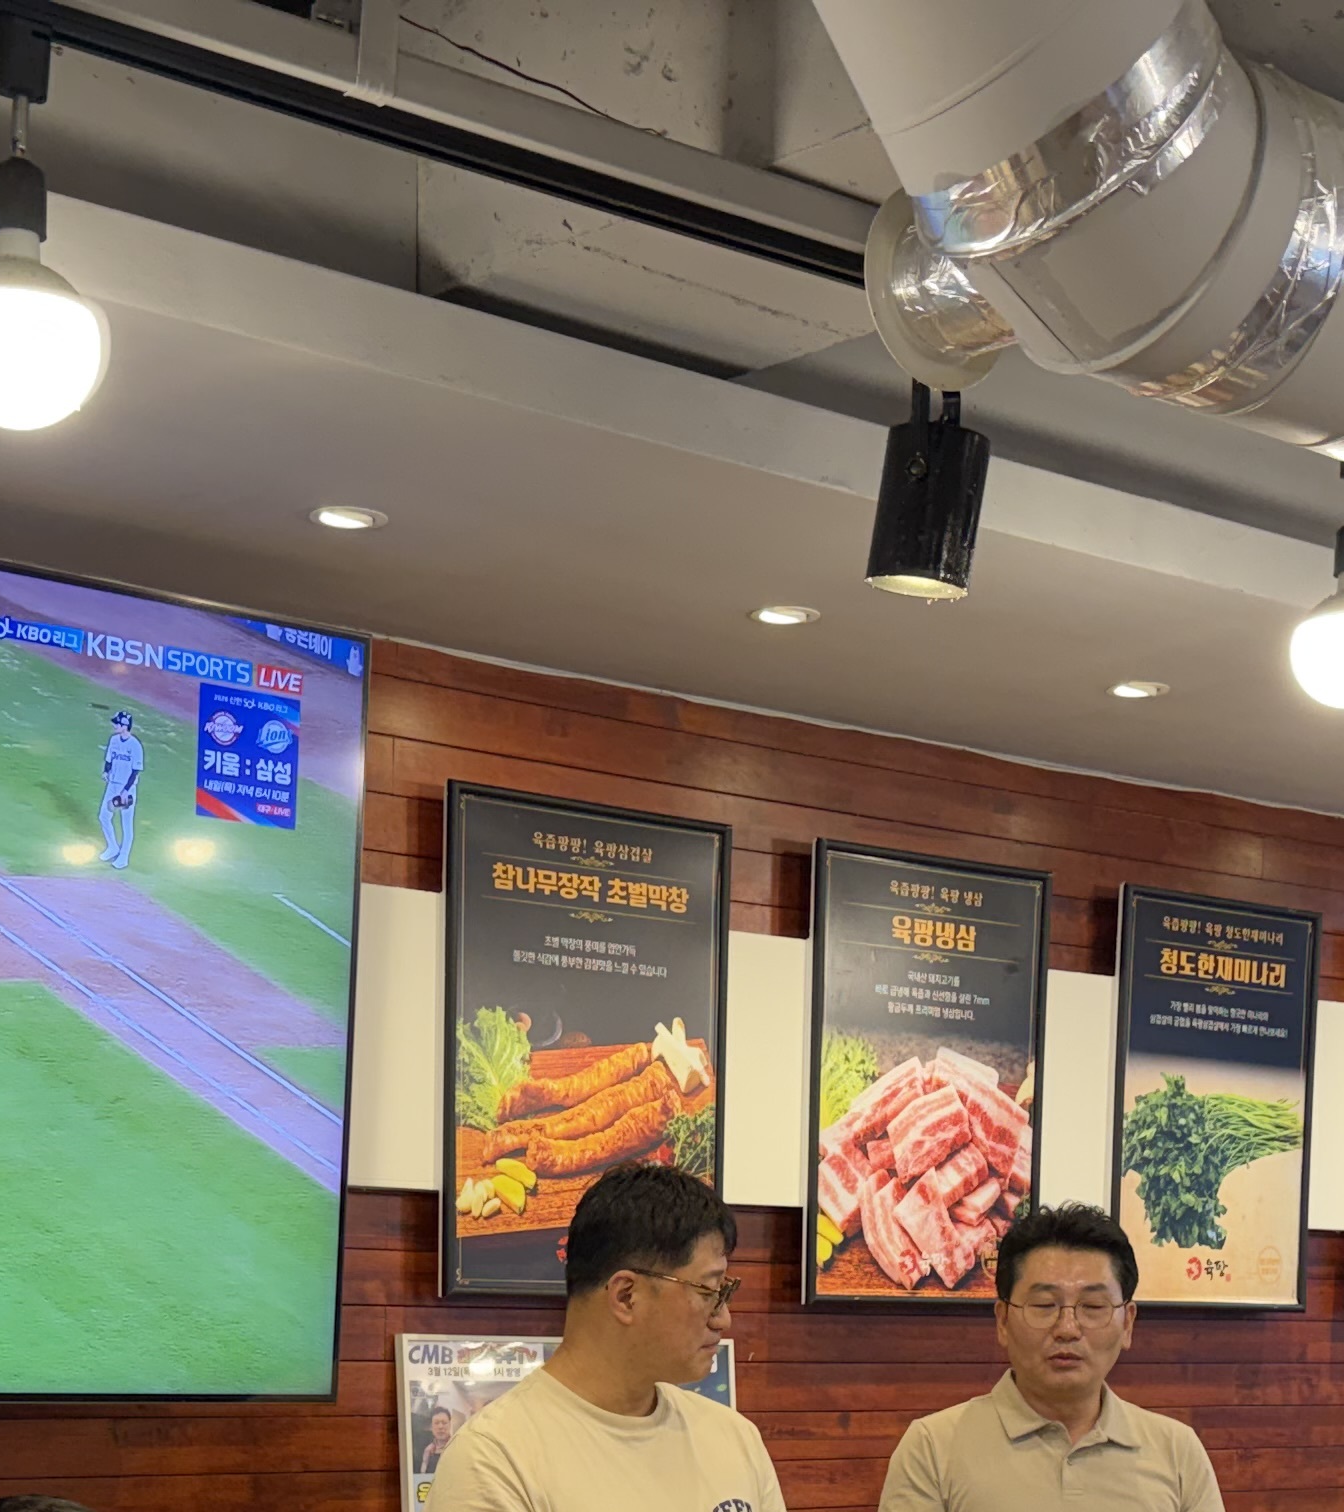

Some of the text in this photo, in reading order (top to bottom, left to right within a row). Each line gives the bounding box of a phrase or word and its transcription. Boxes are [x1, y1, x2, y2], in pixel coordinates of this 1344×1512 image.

[16, 623, 52, 644] KBO
[53, 629, 80, 649] 리그
[87, 632, 302, 693] KBSN SPORTS LIVE
[203, 750, 240, 777] 키움
[255, 758, 292, 785] 삼성
[532, 831, 653, 863] 육즙팡팡! 육팡삼겹살
[492, 861, 689, 914] 참나무장작 초벌막창
[890, 880, 983, 907] 육즙팡팡! 육팡 냉삼
[892, 915, 976, 952] 육팡냉삼
[1160, 947, 1287, 988] 청도한재미나리
[408, 1344, 453, 1365] CMB
